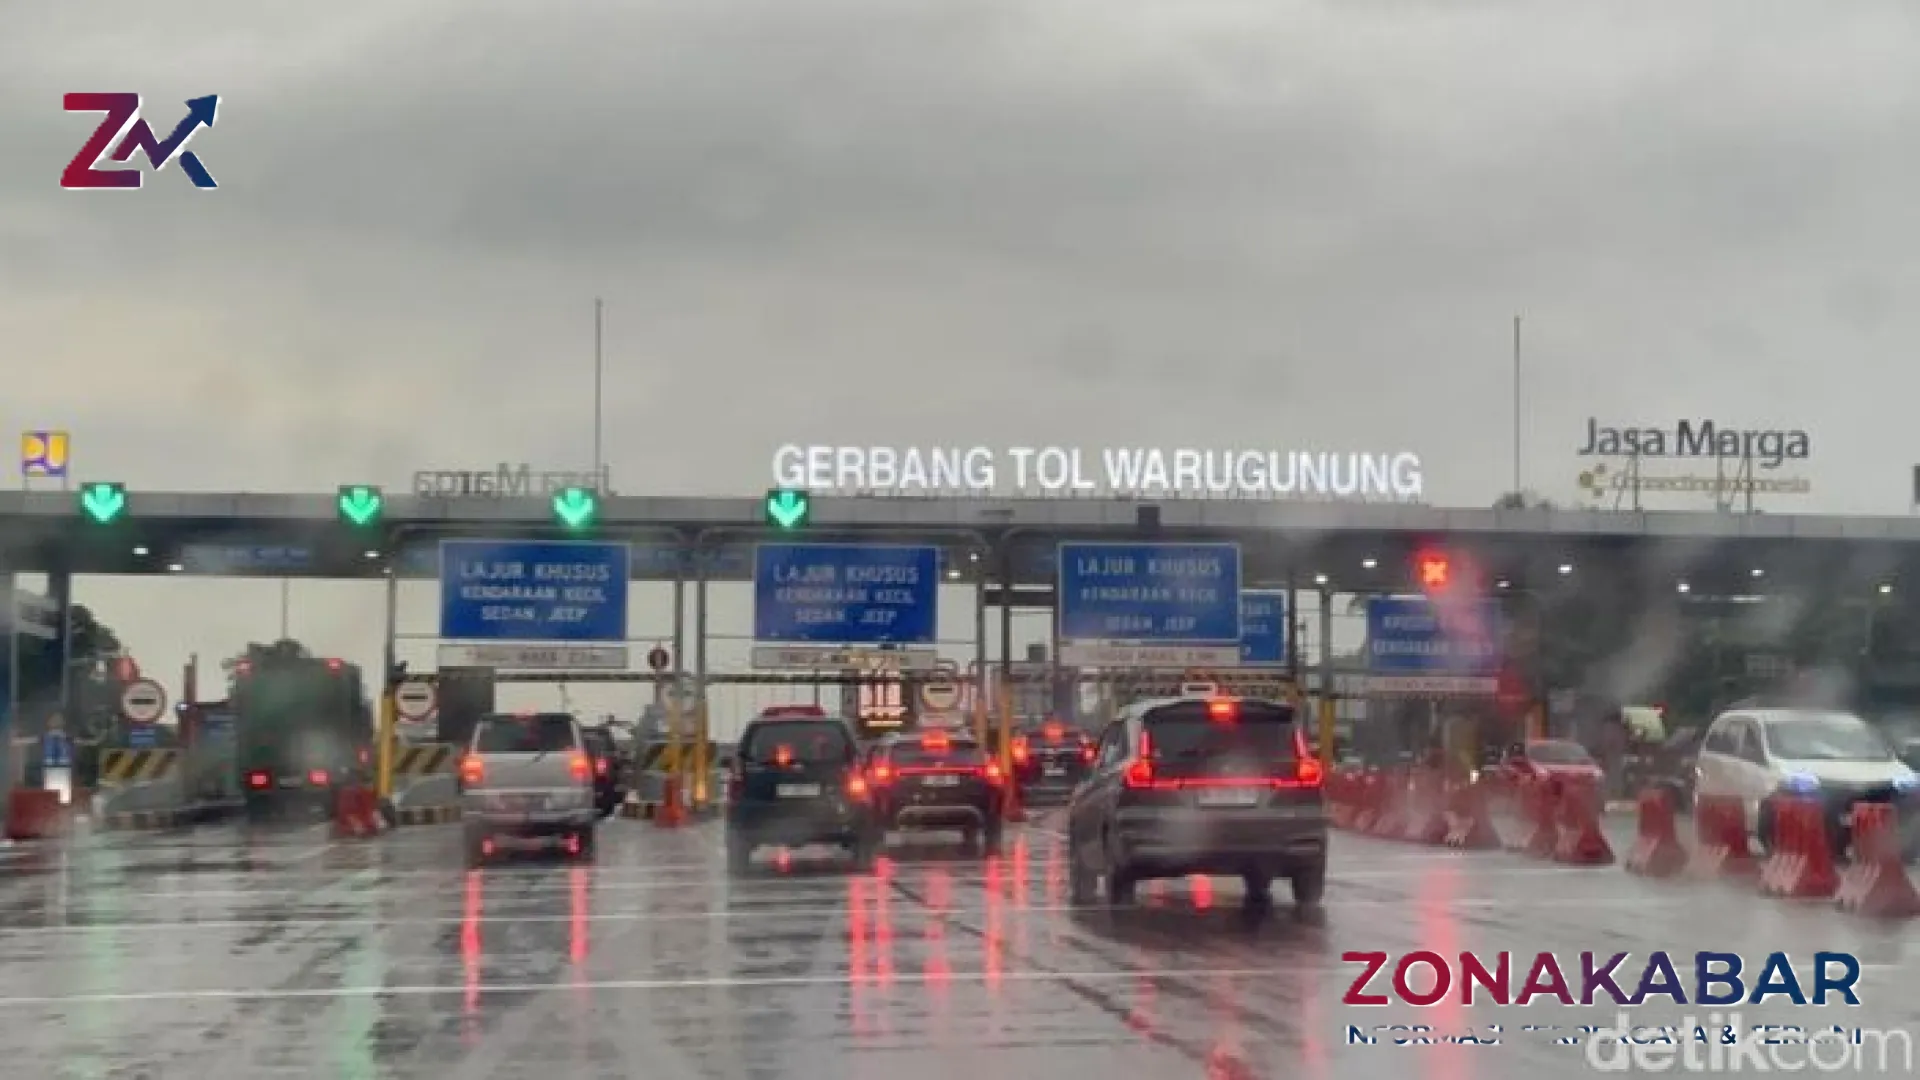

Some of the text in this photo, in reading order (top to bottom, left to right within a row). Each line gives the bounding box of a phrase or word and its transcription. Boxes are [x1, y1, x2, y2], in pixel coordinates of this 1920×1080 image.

[1579, 417, 1809, 469] Jasa Marga
[773, 446, 1423, 496] GERBANG TOL WARUGUNUNG
[461, 560, 611, 581] LAJUR KHUSUS
[773, 564, 919, 584] LAJUR KHUSUS
[1077, 556, 1221, 577] LAJUR KHUSUS
